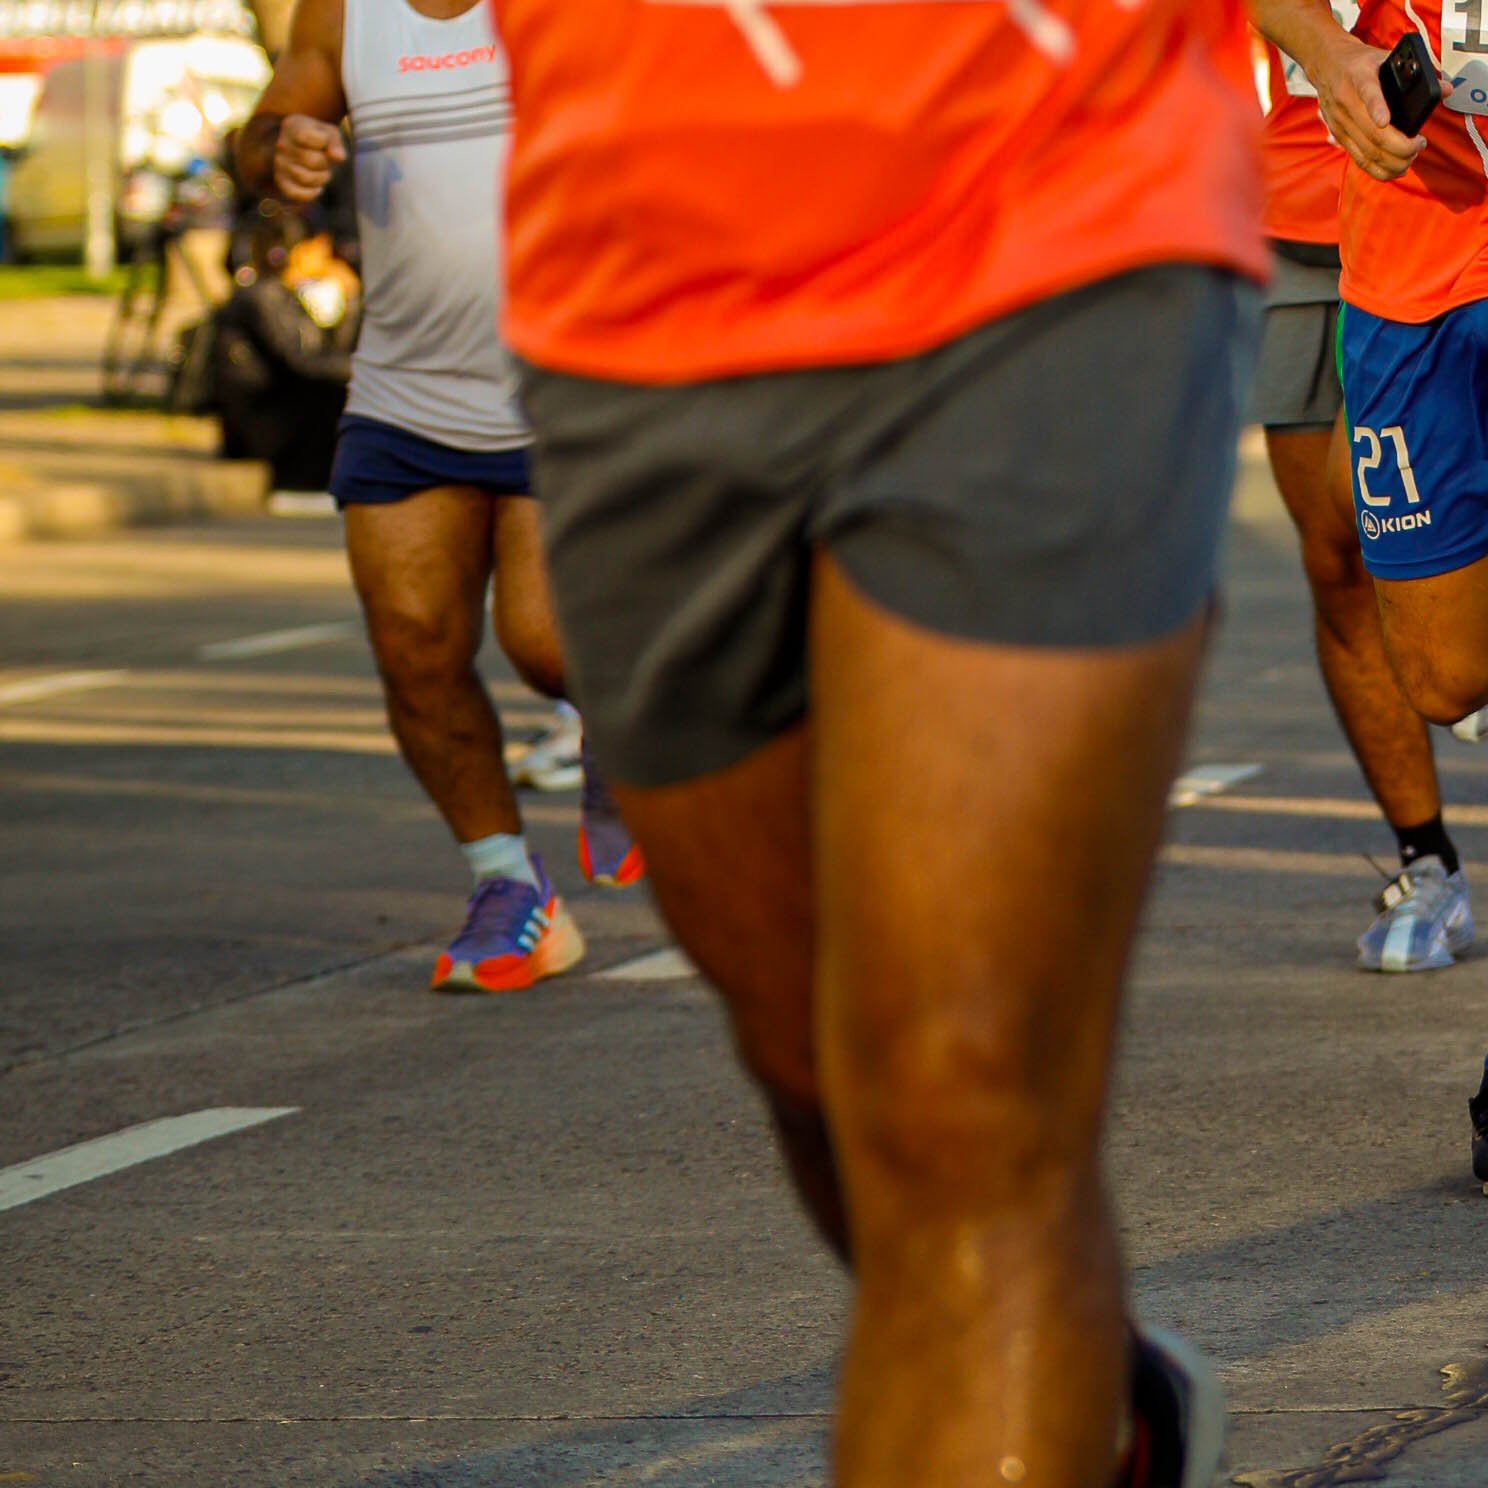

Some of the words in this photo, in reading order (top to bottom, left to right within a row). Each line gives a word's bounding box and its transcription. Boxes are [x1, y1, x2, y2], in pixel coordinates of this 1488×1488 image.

[397, 42, 497, 73] saucony
[1353, 425, 1420, 507] 21
[1382, 509, 1432, 533] KION
